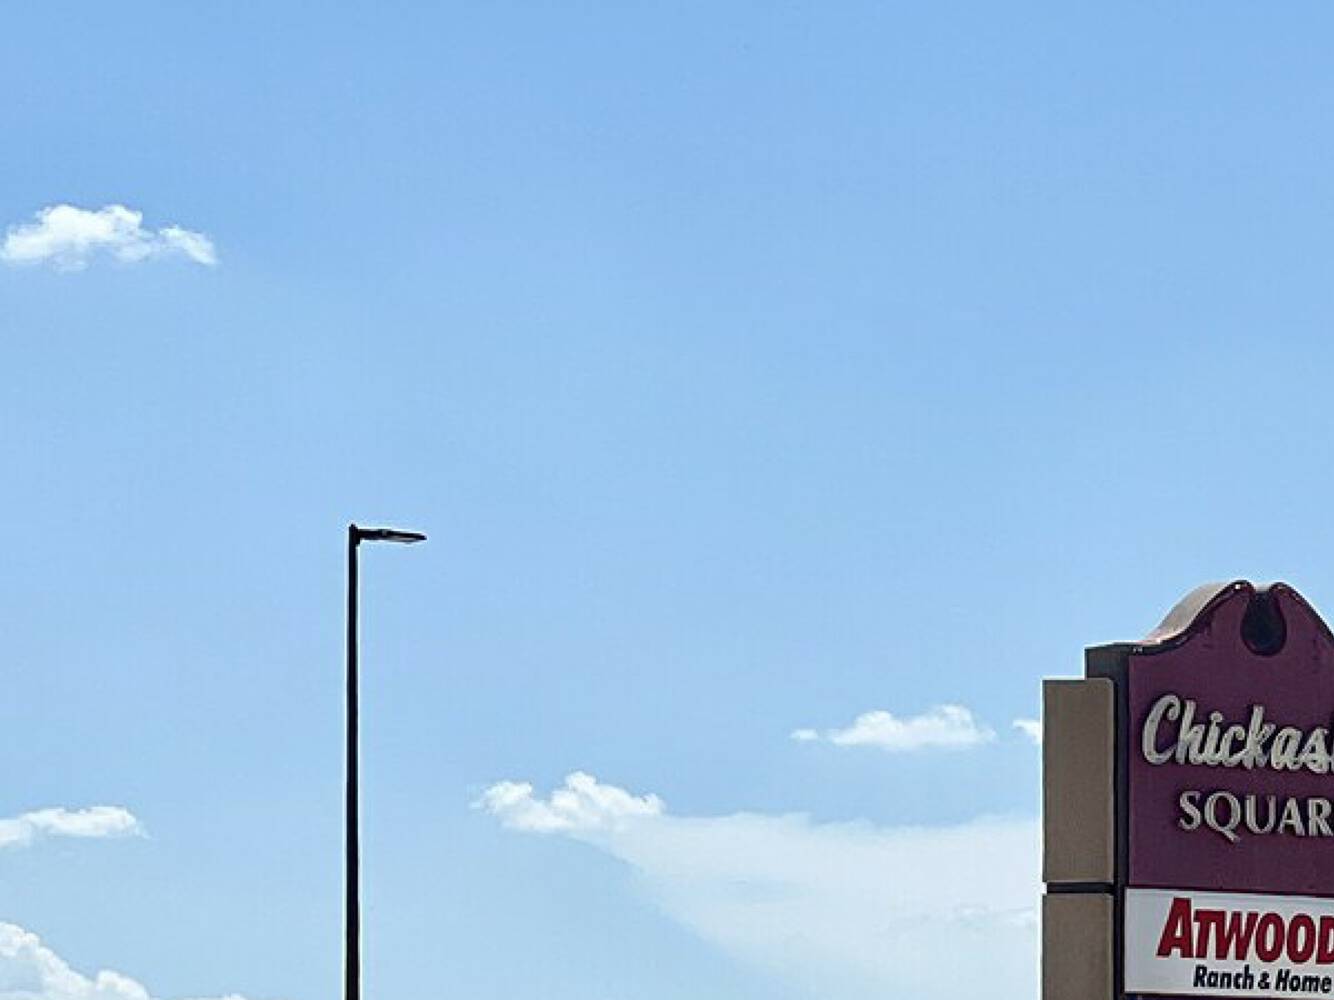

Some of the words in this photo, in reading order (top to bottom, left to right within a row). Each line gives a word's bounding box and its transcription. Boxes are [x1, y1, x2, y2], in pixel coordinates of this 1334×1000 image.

[1193, 964, 1251, 990] Ranch
[1258, 972, 1270, 990] &
[1275, 969, 1333, 993] Home
